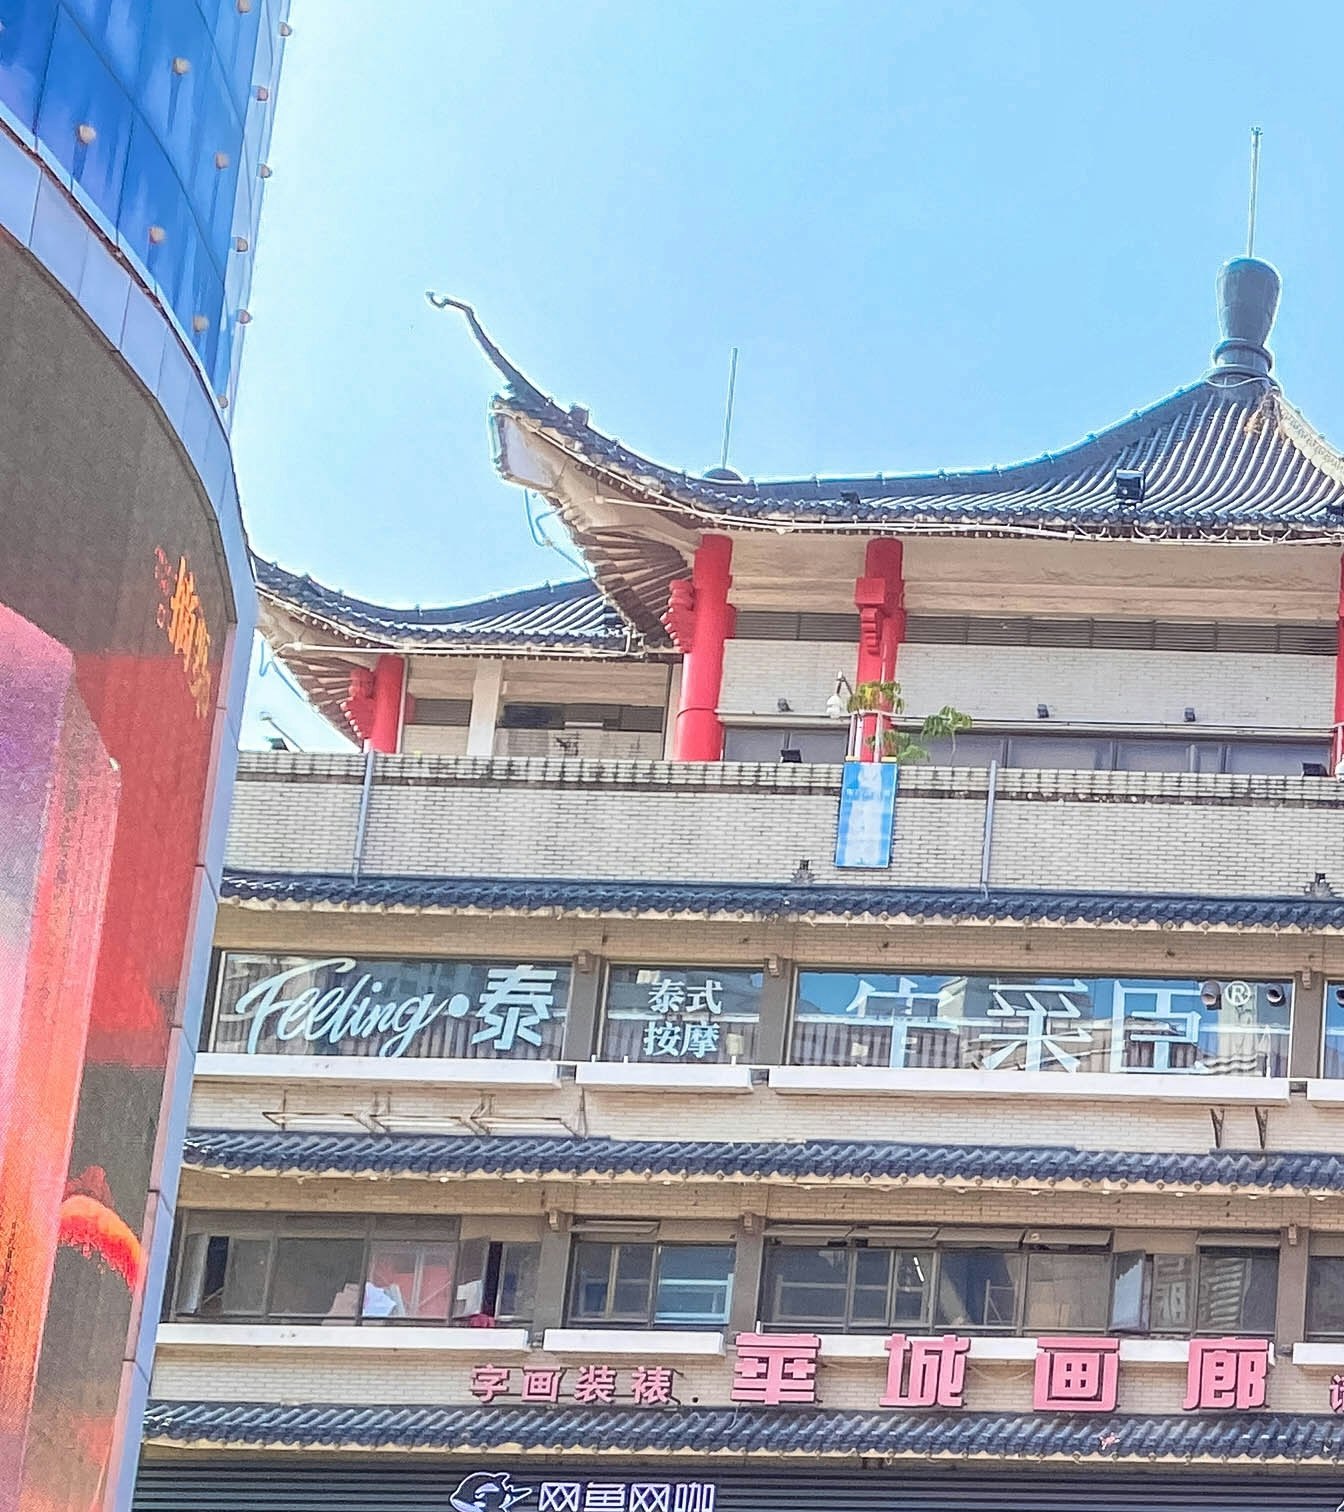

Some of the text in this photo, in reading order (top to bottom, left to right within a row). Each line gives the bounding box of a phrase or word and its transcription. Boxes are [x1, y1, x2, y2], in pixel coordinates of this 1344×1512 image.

[647, 978, 724, 1016] 泰式
[643, 1022, 722, 1058] 按摩
[470, 1364, 674, 1405] 字画装裱
